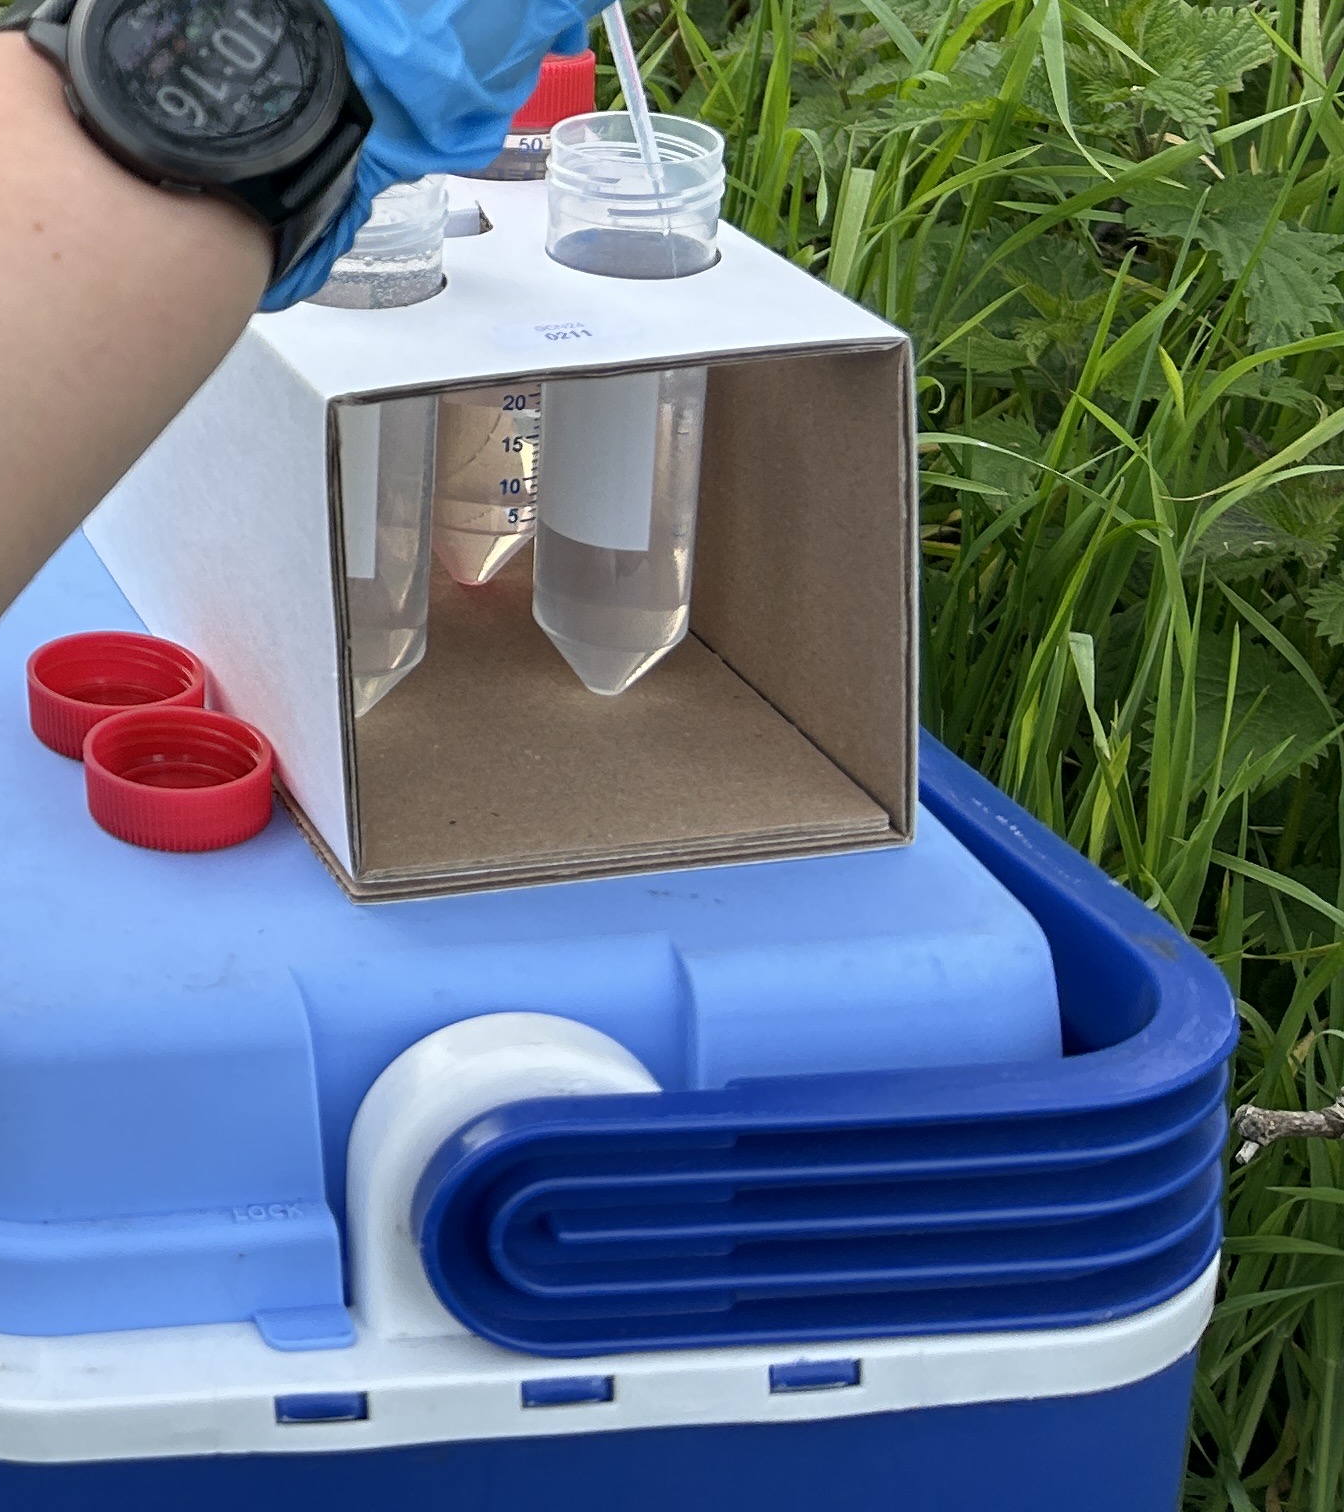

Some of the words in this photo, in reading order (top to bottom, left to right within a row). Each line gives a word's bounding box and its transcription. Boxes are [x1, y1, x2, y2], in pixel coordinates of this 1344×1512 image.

[155, 9, 283, 127] 10:16
[519, 137, 543, 153] 50
[502, 394, 526, 411] 20
[501, 436, 524, 453] 15
[499, 478, 521, 496] 10
[507, 508, 519, 524] 5
